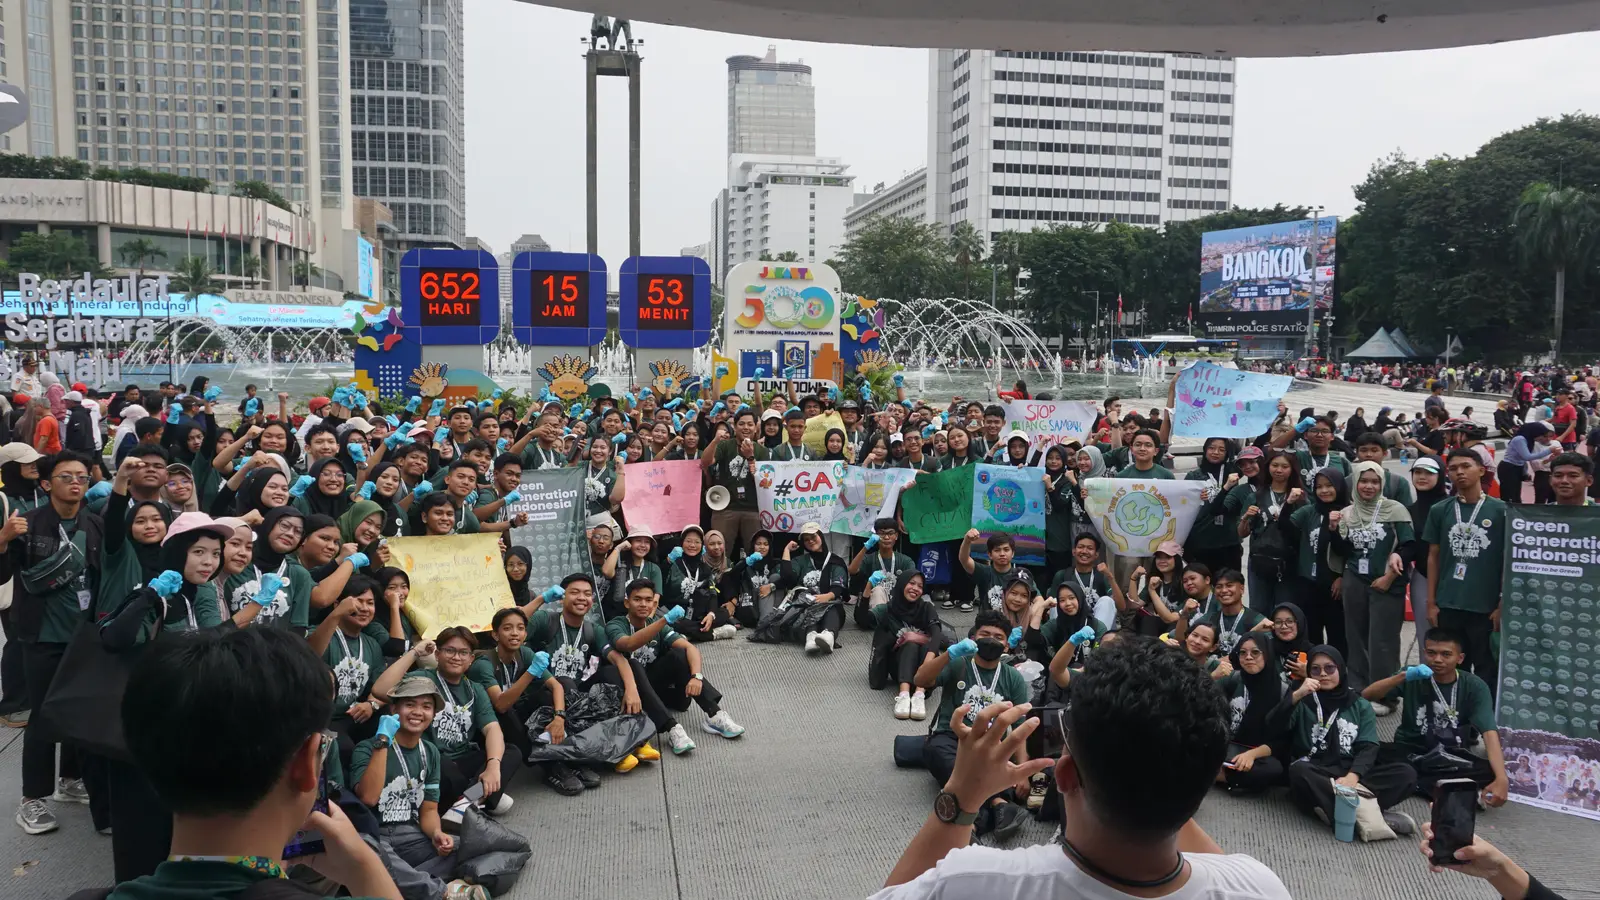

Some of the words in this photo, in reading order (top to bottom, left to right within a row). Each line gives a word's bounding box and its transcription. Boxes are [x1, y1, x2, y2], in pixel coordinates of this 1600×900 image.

[1222, 246, 1308, 281] BANGKOK
[759, 266, 814, 279] JAKARTA
[19, 272, 170, 303] Berdaulat
[420, 272, 480, 300] 652
[543, 275, 578, 302] 15
[648, 279, 684, 305] 53
[117, 300, 190, 312] Terlndungi
[236, 292, 272, 303] PLAZA
[276, 293, 333, 305] INDONESIA
[428, 302, 471, 315] HARI
[541, 304, 576, 317] JAM
[639, 307, 690, 321] MENIT
[239, 316, 272, 324] Sehatnya
[300, 318, 336, 326] Terlindungi
[4, 311, 156, 349] Sejahtera
[50, 351, 121, 389] Maju
[1025, 404, 1056, 421] STOP
[1011, 421, 1047, 431] BUANG
[517, 482, 544, 491] reen
[518, 489, 578, 502] eneration
[773, 494, 837, 511] NYAMPA
[509, 499, 572, 512] Indonesia
[1512, 518, 1570, 533] Green
[1511, 532, 1600, 550] Generati
[1512, 546, 1600, 564] Indonesi
